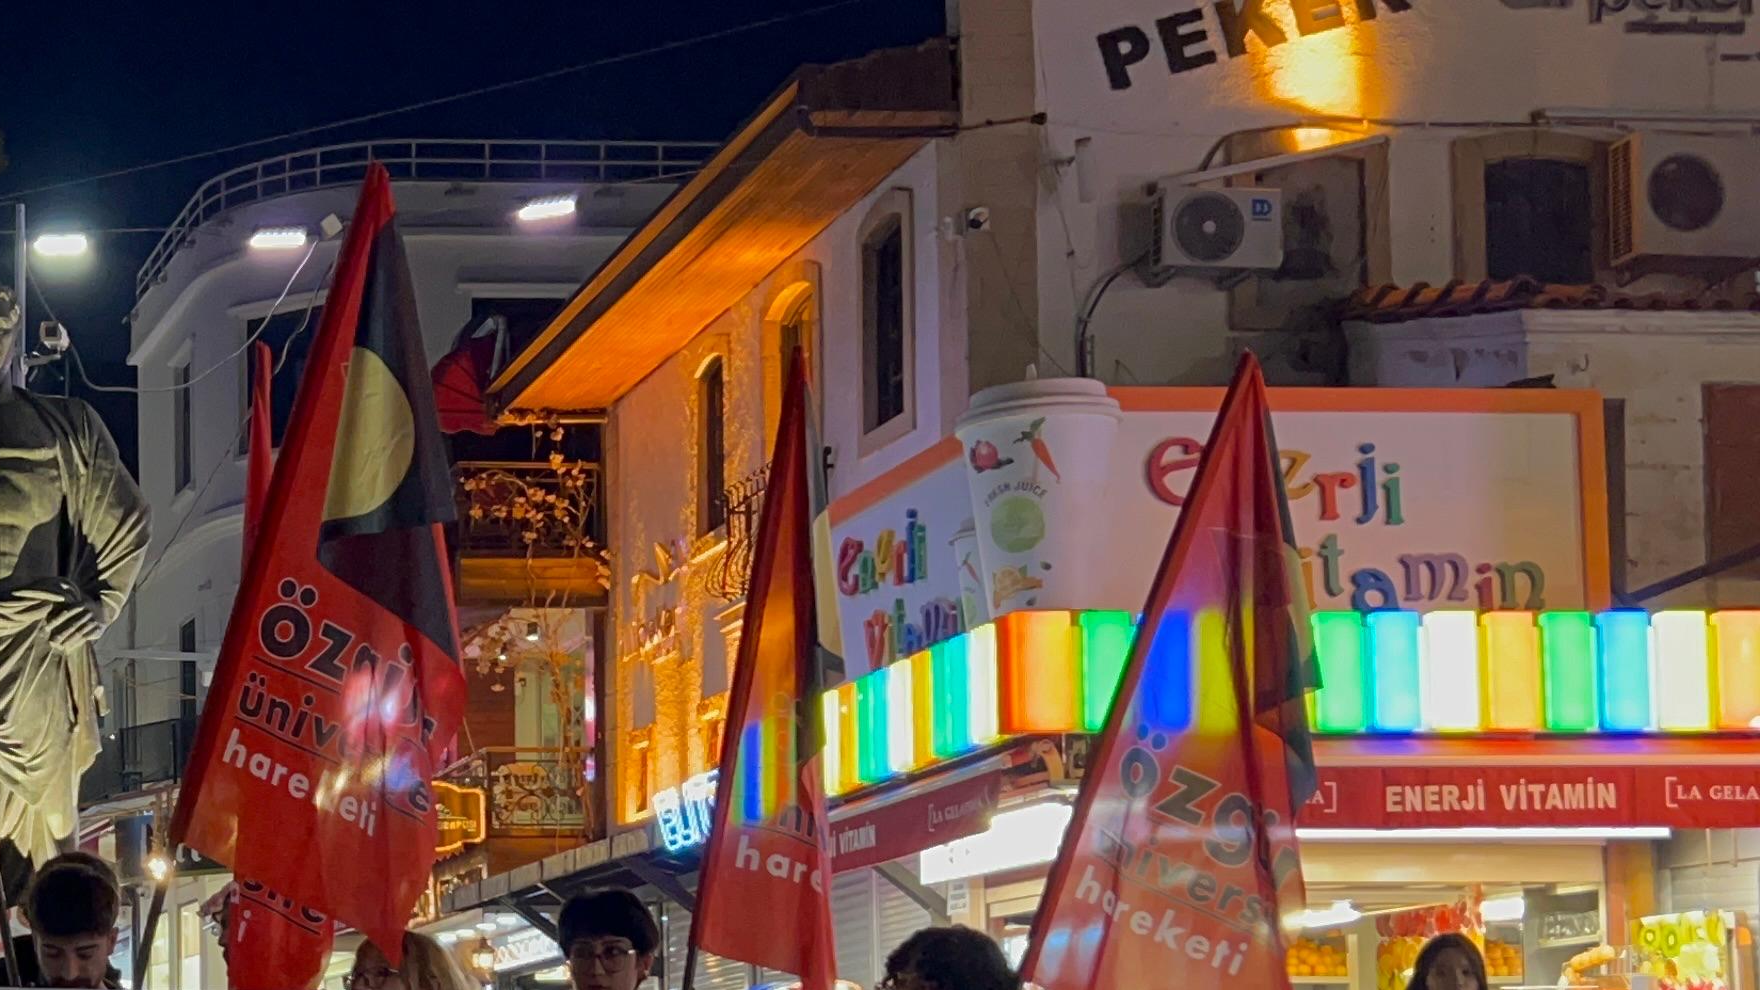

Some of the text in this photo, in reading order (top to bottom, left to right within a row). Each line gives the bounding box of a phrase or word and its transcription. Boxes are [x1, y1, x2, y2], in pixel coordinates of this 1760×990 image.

[1013, 480, 1049, 500] JUICE
[1145, 436, 1404, 526] erji
[1296, 533, 1547, 611] itamin
[1385, 776, 1618, 813] ENERJİ VİTAMİN
[1074, 863, 1249, 977] hareketi
